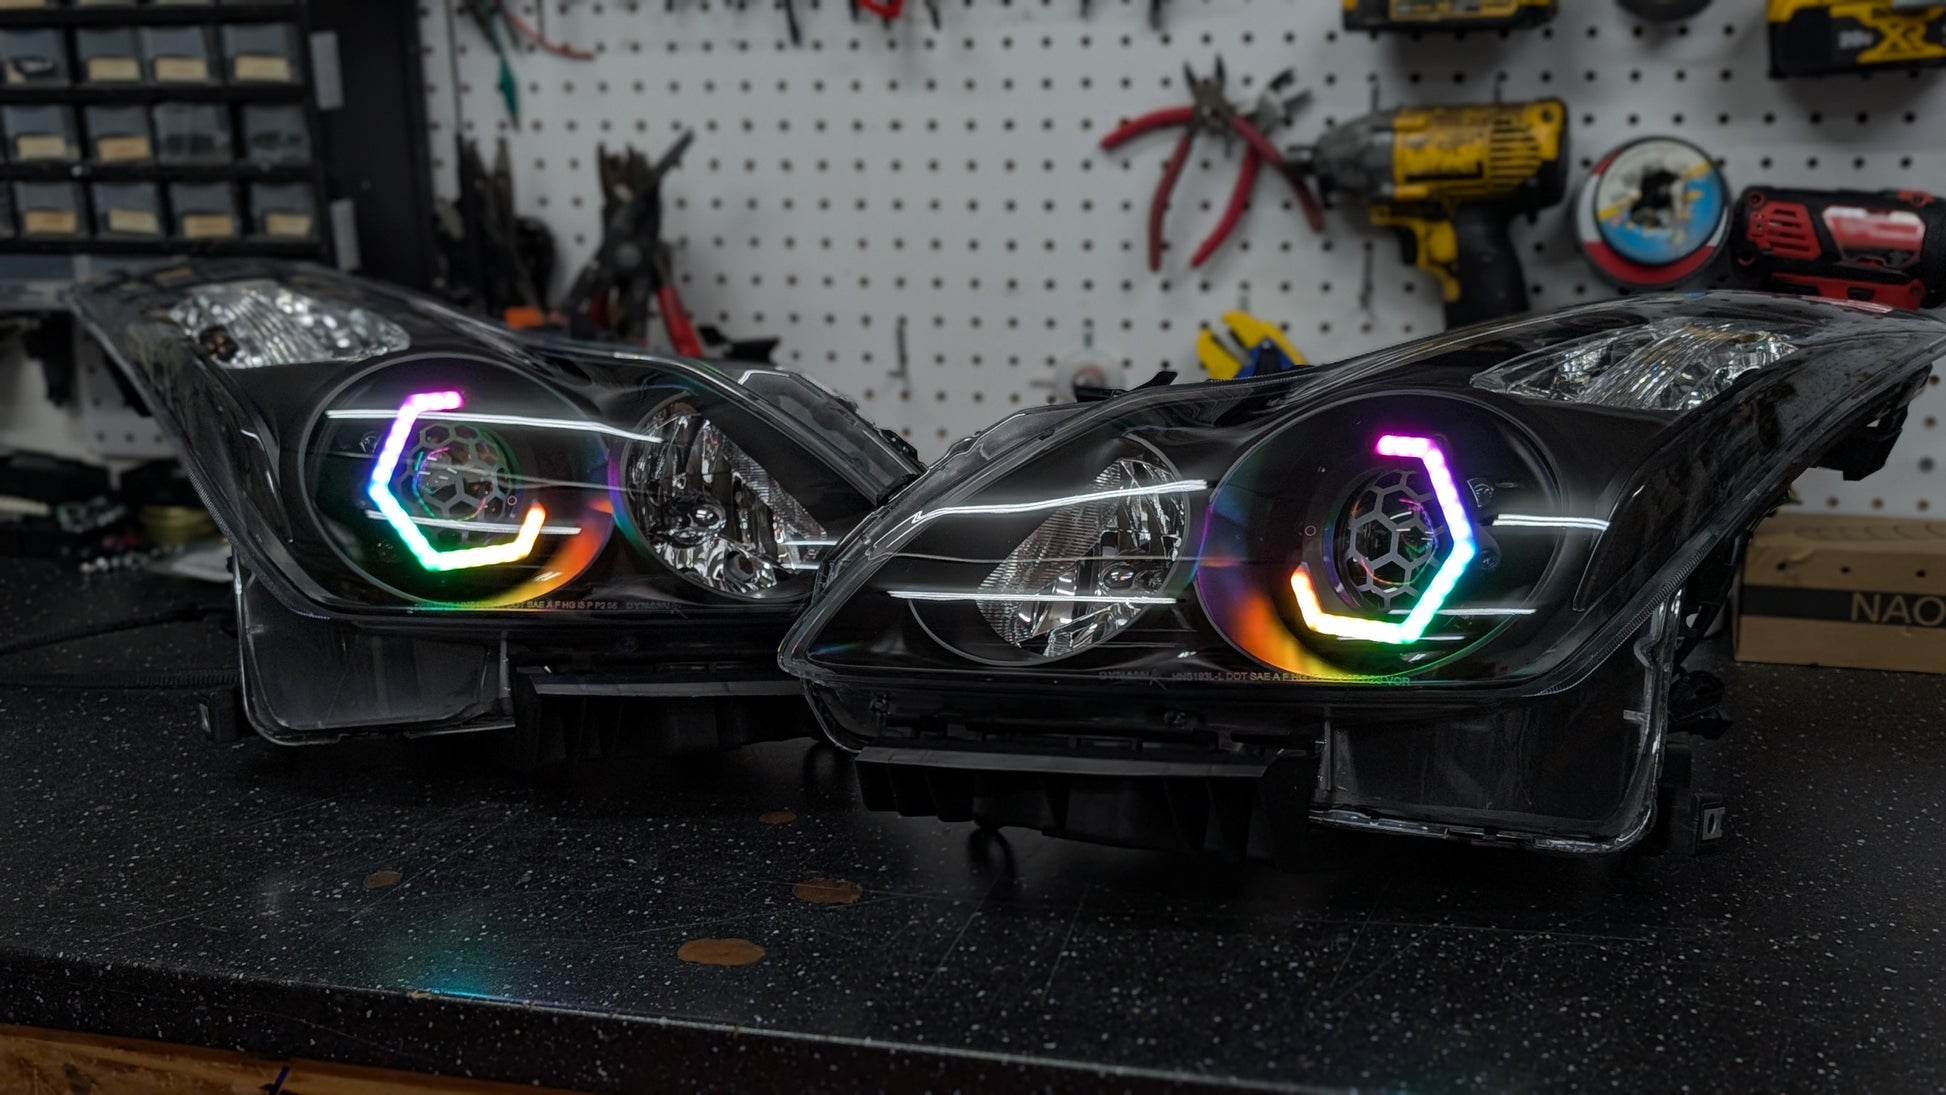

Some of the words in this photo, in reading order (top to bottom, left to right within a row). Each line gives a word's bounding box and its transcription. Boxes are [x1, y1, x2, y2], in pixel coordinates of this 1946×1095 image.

[1850, 592, 1946, 626] NAO
[1226, 672, 1247, 681] DOT
[1249, 672, 1270, 681] SAE
[1272, 672, 1280, 681] A
